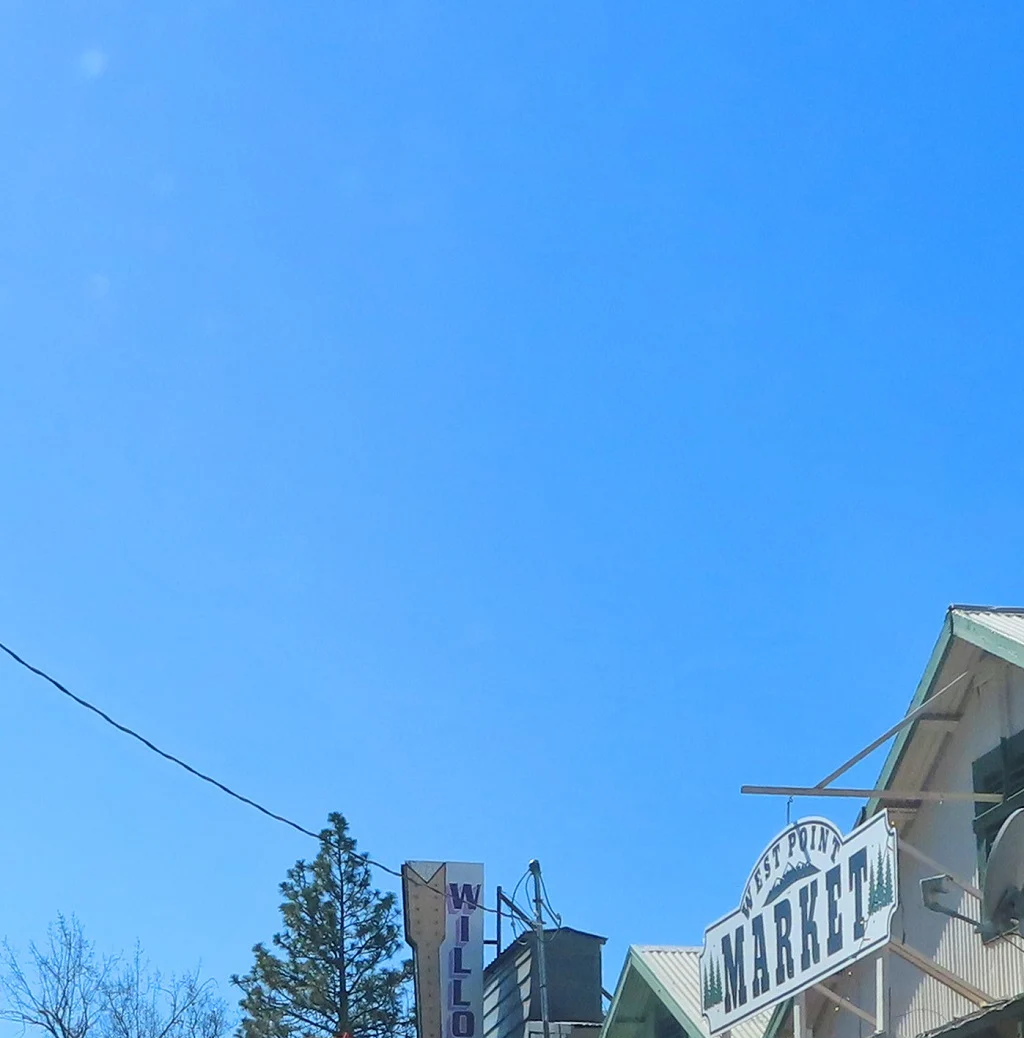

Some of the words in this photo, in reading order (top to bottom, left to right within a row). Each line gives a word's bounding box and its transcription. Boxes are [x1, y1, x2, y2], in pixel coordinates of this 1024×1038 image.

[721, 846, 868, 1014] MARKET
[742, 843, 781, 920] WEST
[788, 825, 841, 865] POINT
